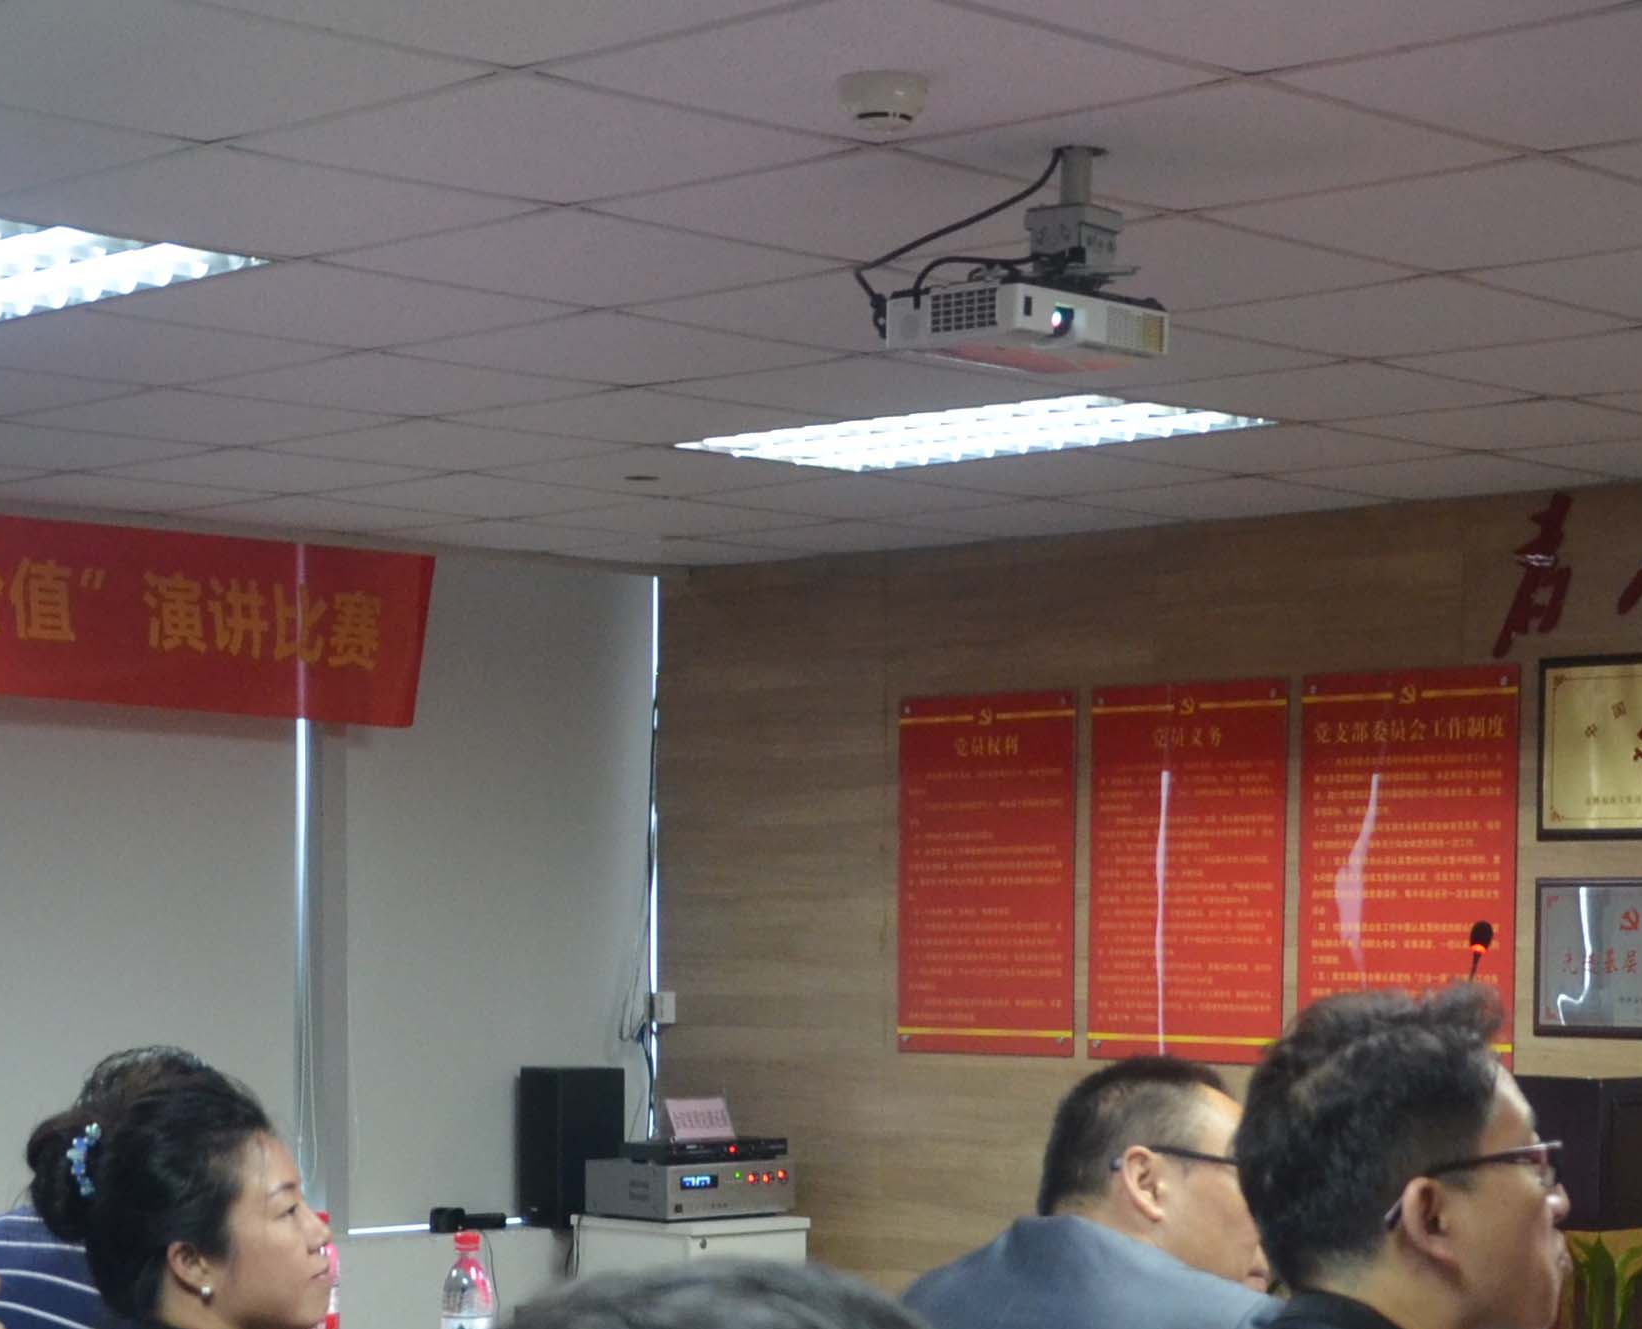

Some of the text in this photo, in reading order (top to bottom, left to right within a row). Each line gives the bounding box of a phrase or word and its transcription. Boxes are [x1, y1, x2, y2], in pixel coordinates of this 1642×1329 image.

[142, 569, 385, 672] 演讲比赛
[1314, 716, 1506, 745] 党支部委员会工作制度
